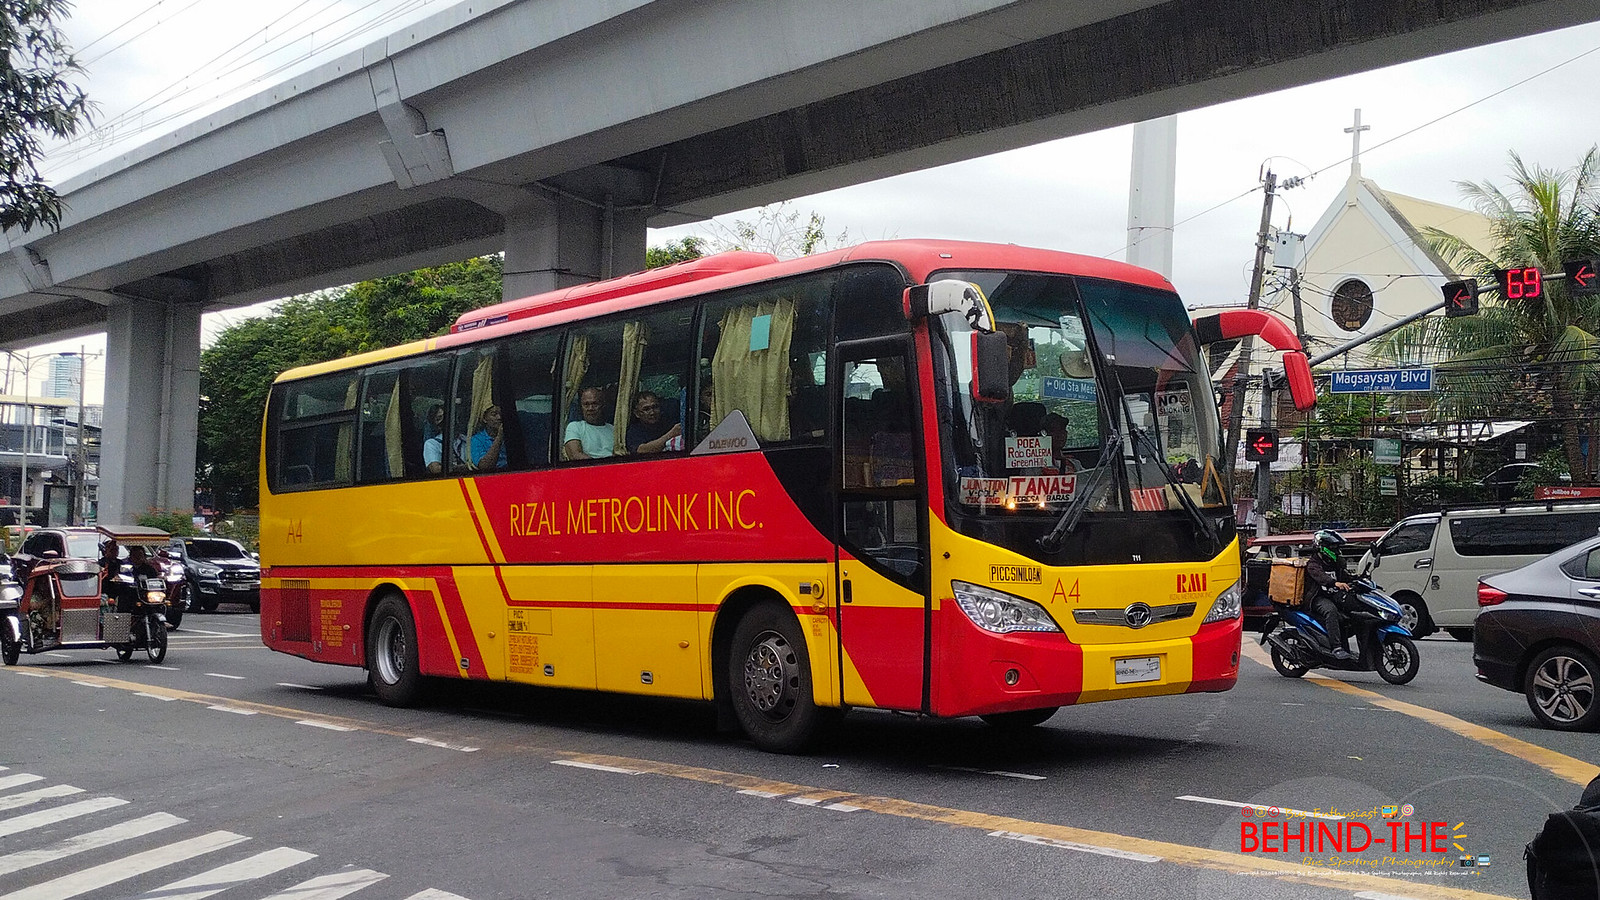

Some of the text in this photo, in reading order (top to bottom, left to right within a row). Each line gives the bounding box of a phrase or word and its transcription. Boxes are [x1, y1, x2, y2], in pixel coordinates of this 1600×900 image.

[1507, 267, 1540, 299] 69
[1053, 379, 1066, 390] Old
[1067, 381, 1079, 393] Sta
[1335, 370, 1427, 387] Magsaysay Blvd
[1158, 394, 1178, 407] NO
[709, 437, 748, 449] DAEWOO
[1016, 438, 1041, 448] POEA
[1025, 449, 1051, 458] GALERIA
[1011, 477, 1075, 495] TANAY
[965, 496, 1001, 504] TIKING
[1046, 494, 1070, 503] BARAS
[510, 489, 763, 536] RIZAL METROLINK INC.
[286, 518, 303, 544] A4
[1176, 572, 1207, 593] RMI
[1050, 577, 1081, 604] A4
